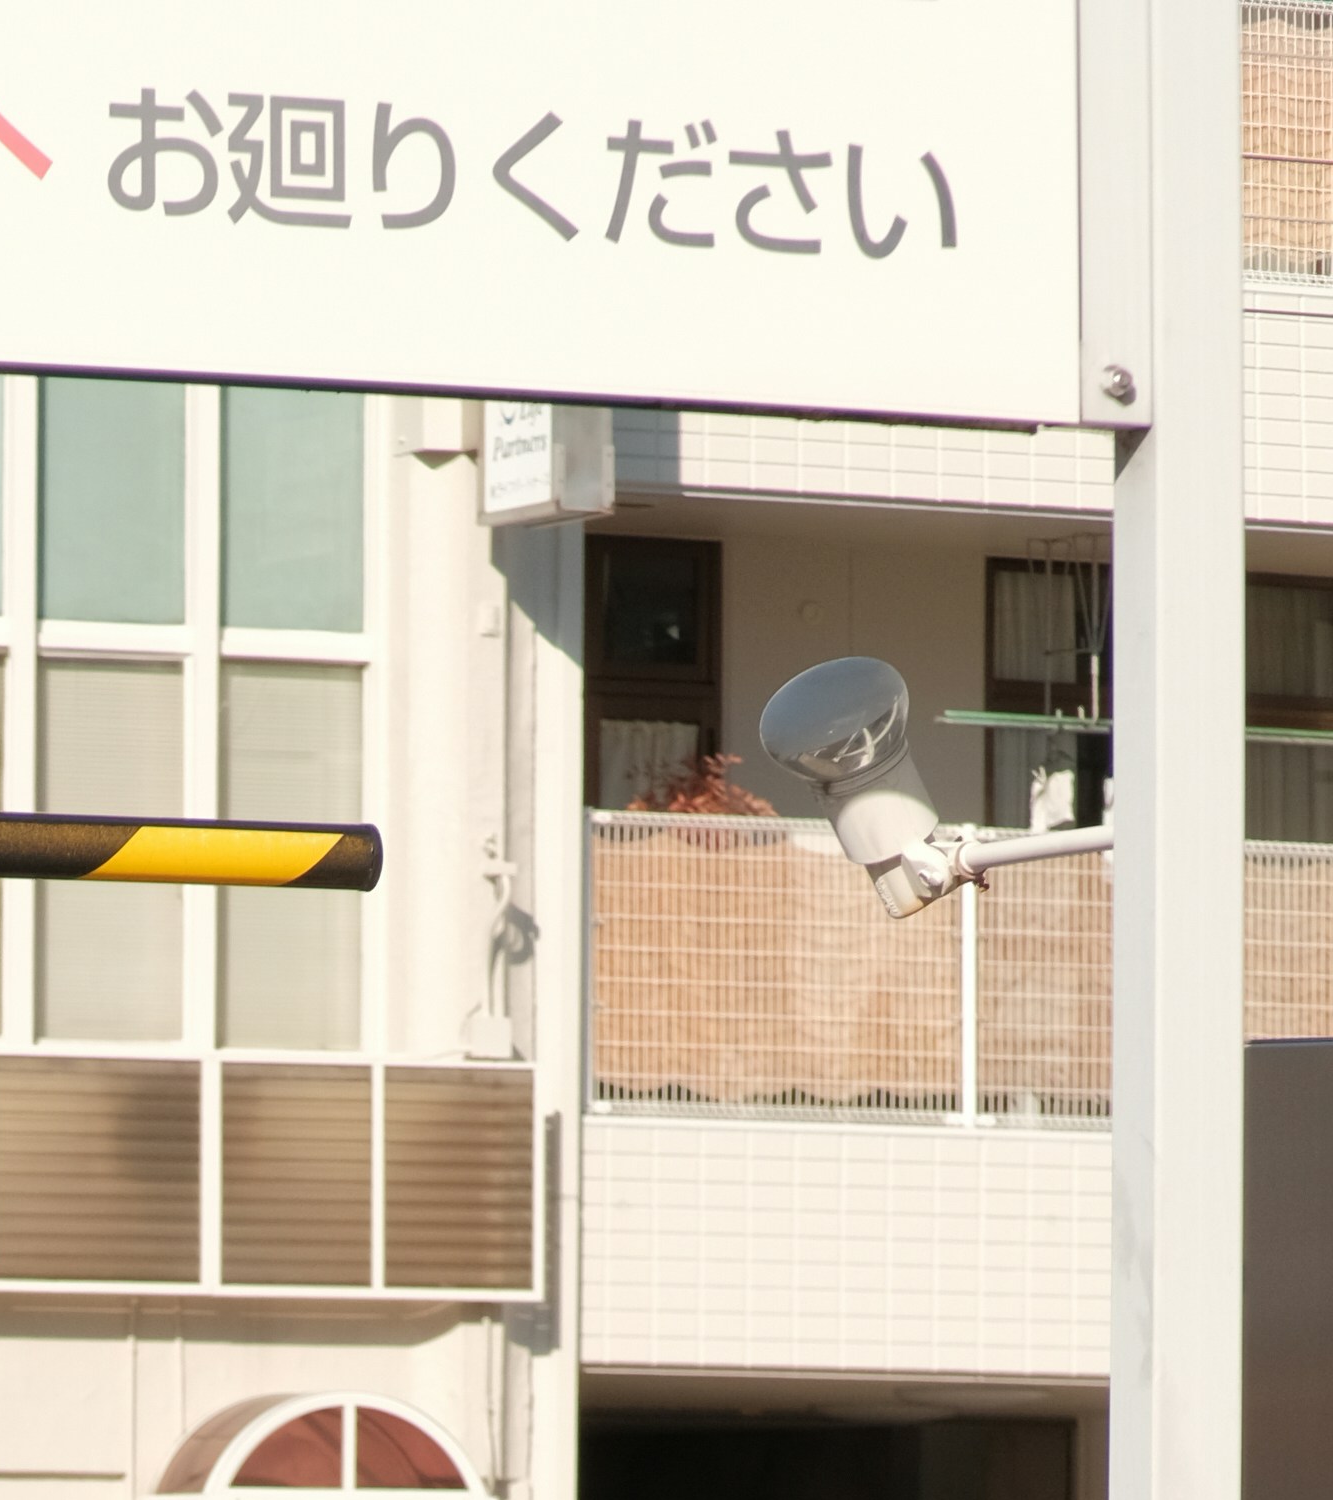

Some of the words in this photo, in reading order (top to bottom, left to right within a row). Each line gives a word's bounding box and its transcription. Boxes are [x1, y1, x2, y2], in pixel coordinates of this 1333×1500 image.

[107, 87, 957, 260] お廻りください
